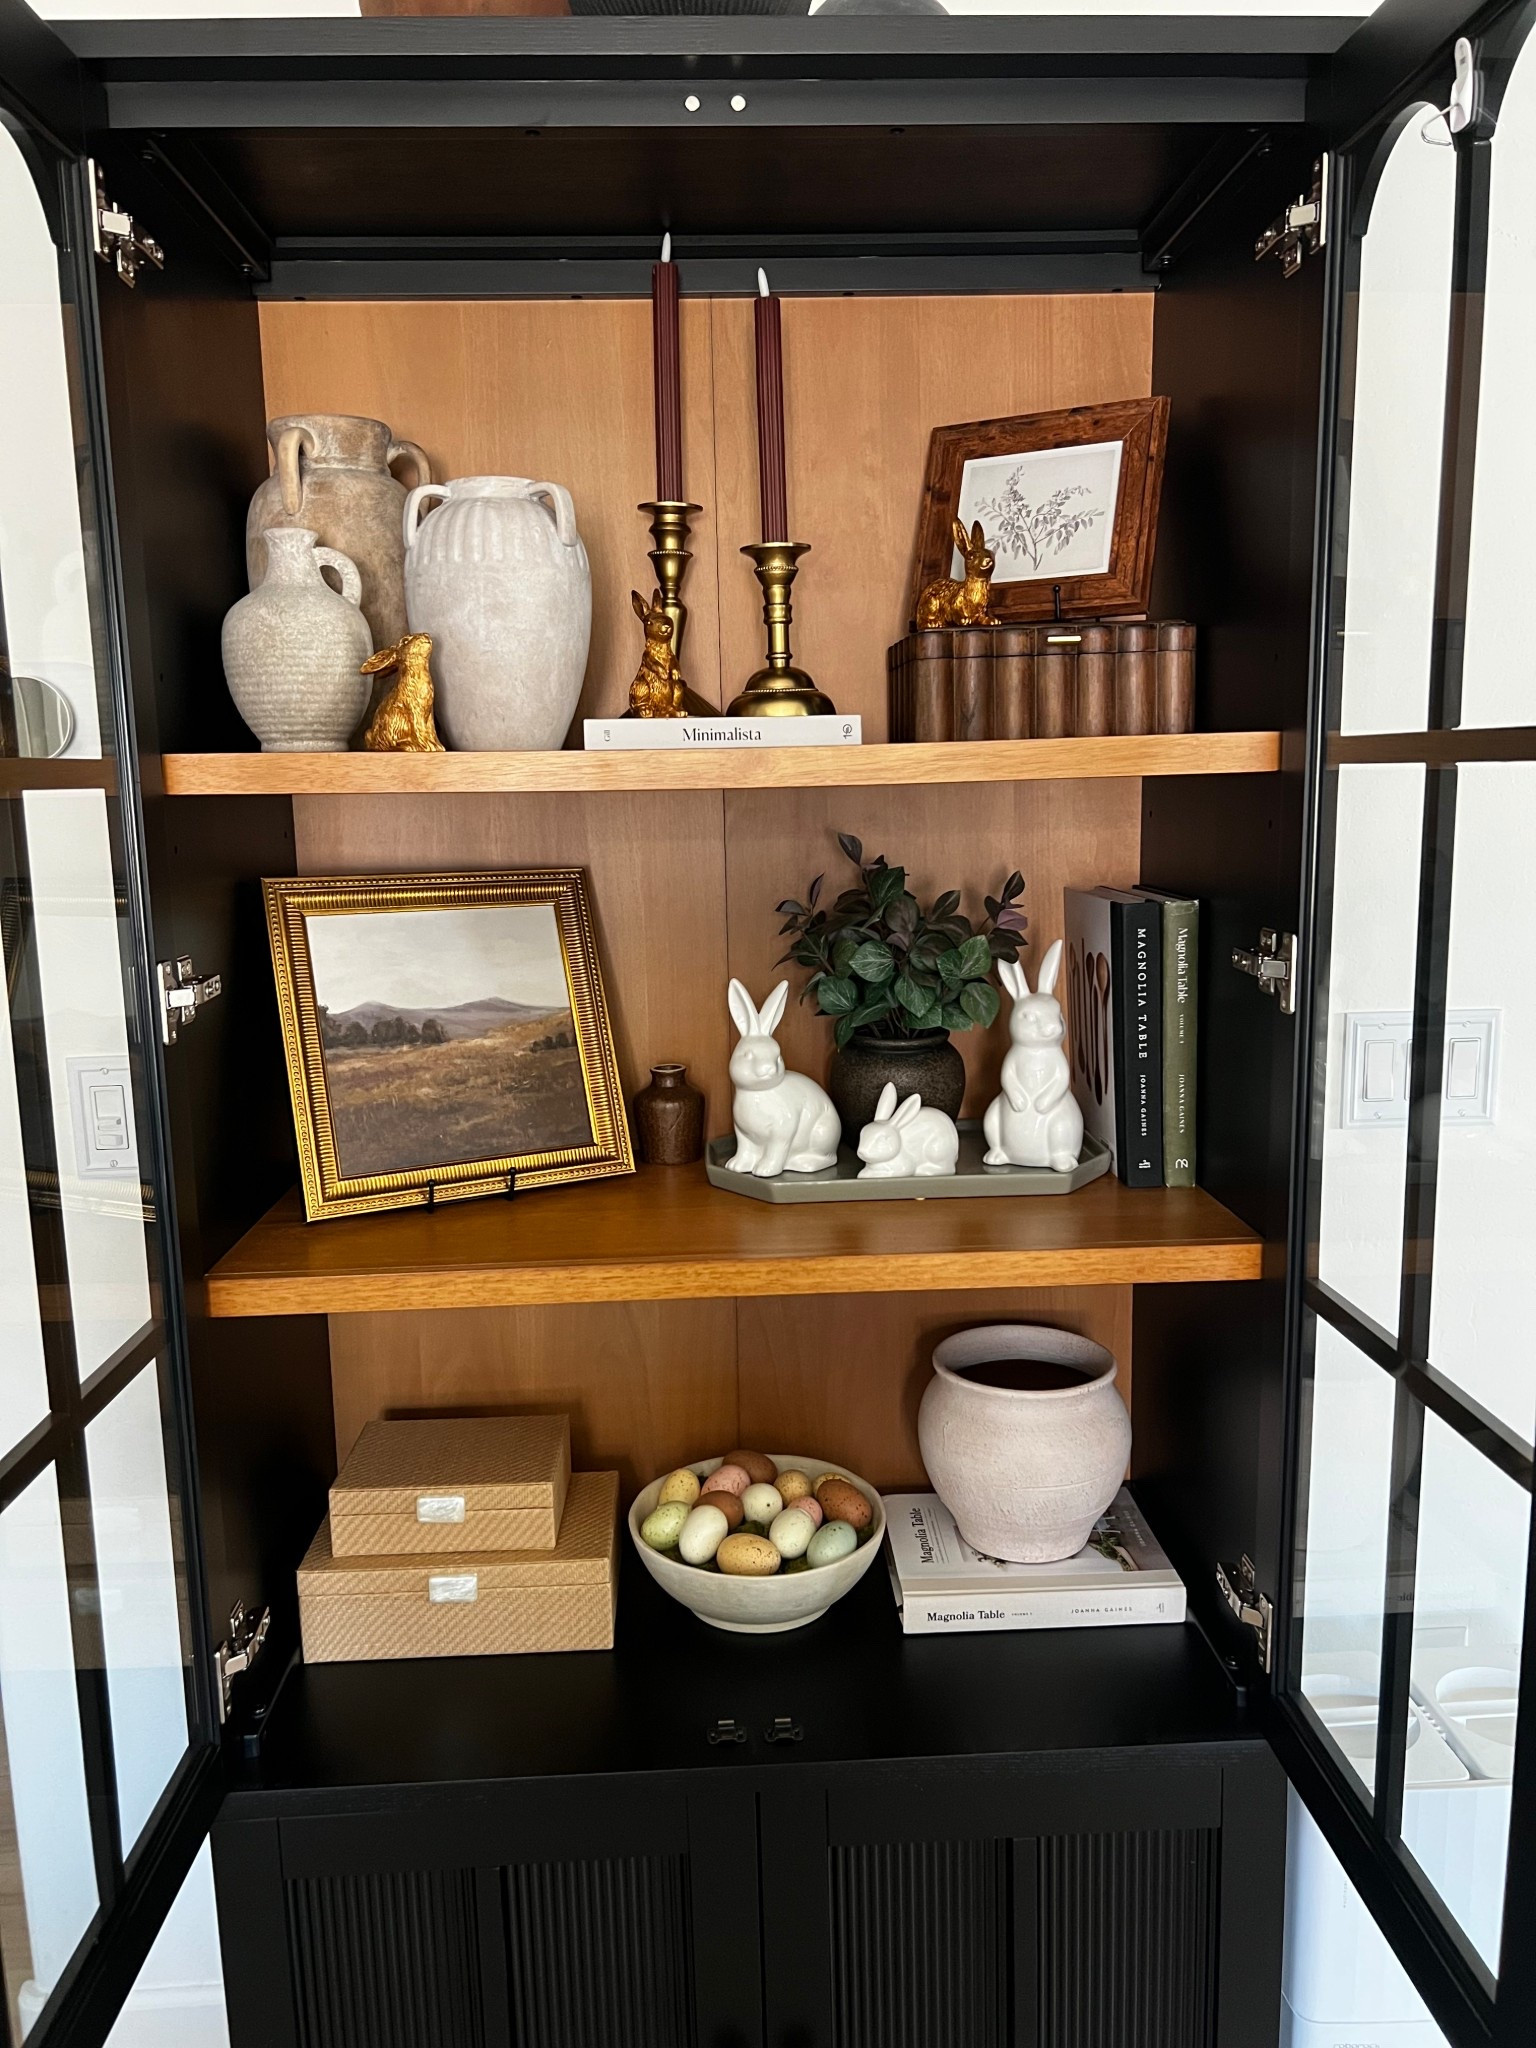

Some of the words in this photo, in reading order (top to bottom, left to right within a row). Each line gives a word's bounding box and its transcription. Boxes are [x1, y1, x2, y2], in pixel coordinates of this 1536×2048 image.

[603, 729, 611, 742] Gill
[682, 726, 762, 741] Minimalista
[1175, 927, 1189, 975] Magnolia
[1137, 928, 1147, 1007] MAGNOLIA
[1177, 975, 1189, 1004] Table
[1138, 1014, 1148, 1058] TABLE
[1140, 1107, 1148, 1136] GAINES
[1178, 1105, 1186, 1134] GAINES
[909, 1507, 925, 1528] Table
[914, 1528, 935, 1564] Magnolia
[927, 1611, 975, 1623] Magnolia
[977, 1609, 1006, 1620] Table
